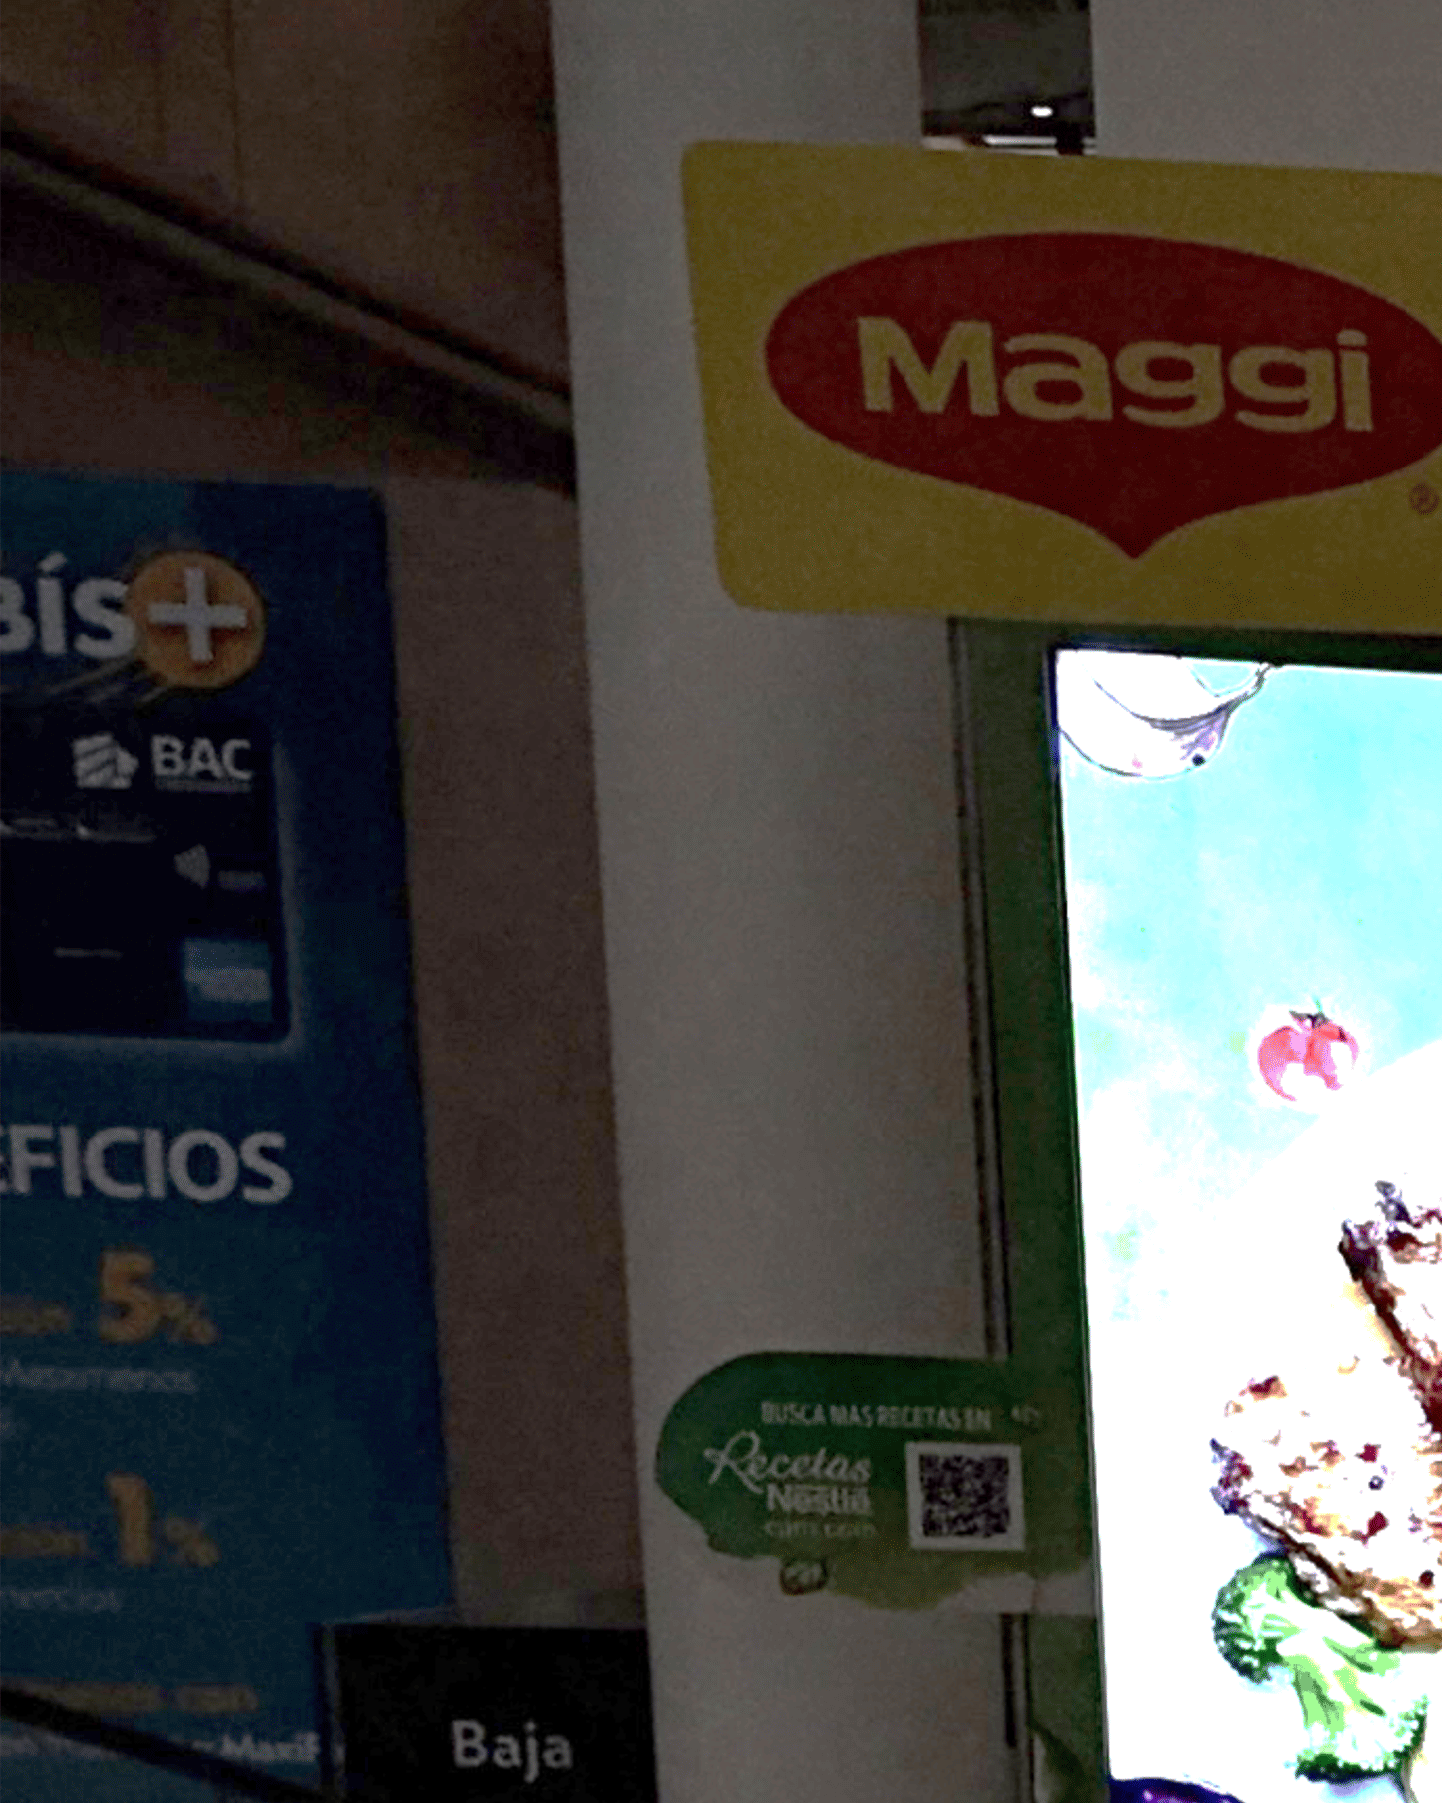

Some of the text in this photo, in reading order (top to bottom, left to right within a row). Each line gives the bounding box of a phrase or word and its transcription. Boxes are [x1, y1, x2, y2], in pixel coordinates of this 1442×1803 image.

[857, 315, 1375, 434] Maggi
[151, 733, 254, 781] BAC
[0, 1124, 293, 1203] FICIOS
[761, 1401, 826, 1426] BUSCA
[877, 1405, 960, 1430] RECETAS
[704, 1430, 872, 1495] Recetas
[451, 1718, 574, 1784] Baja
